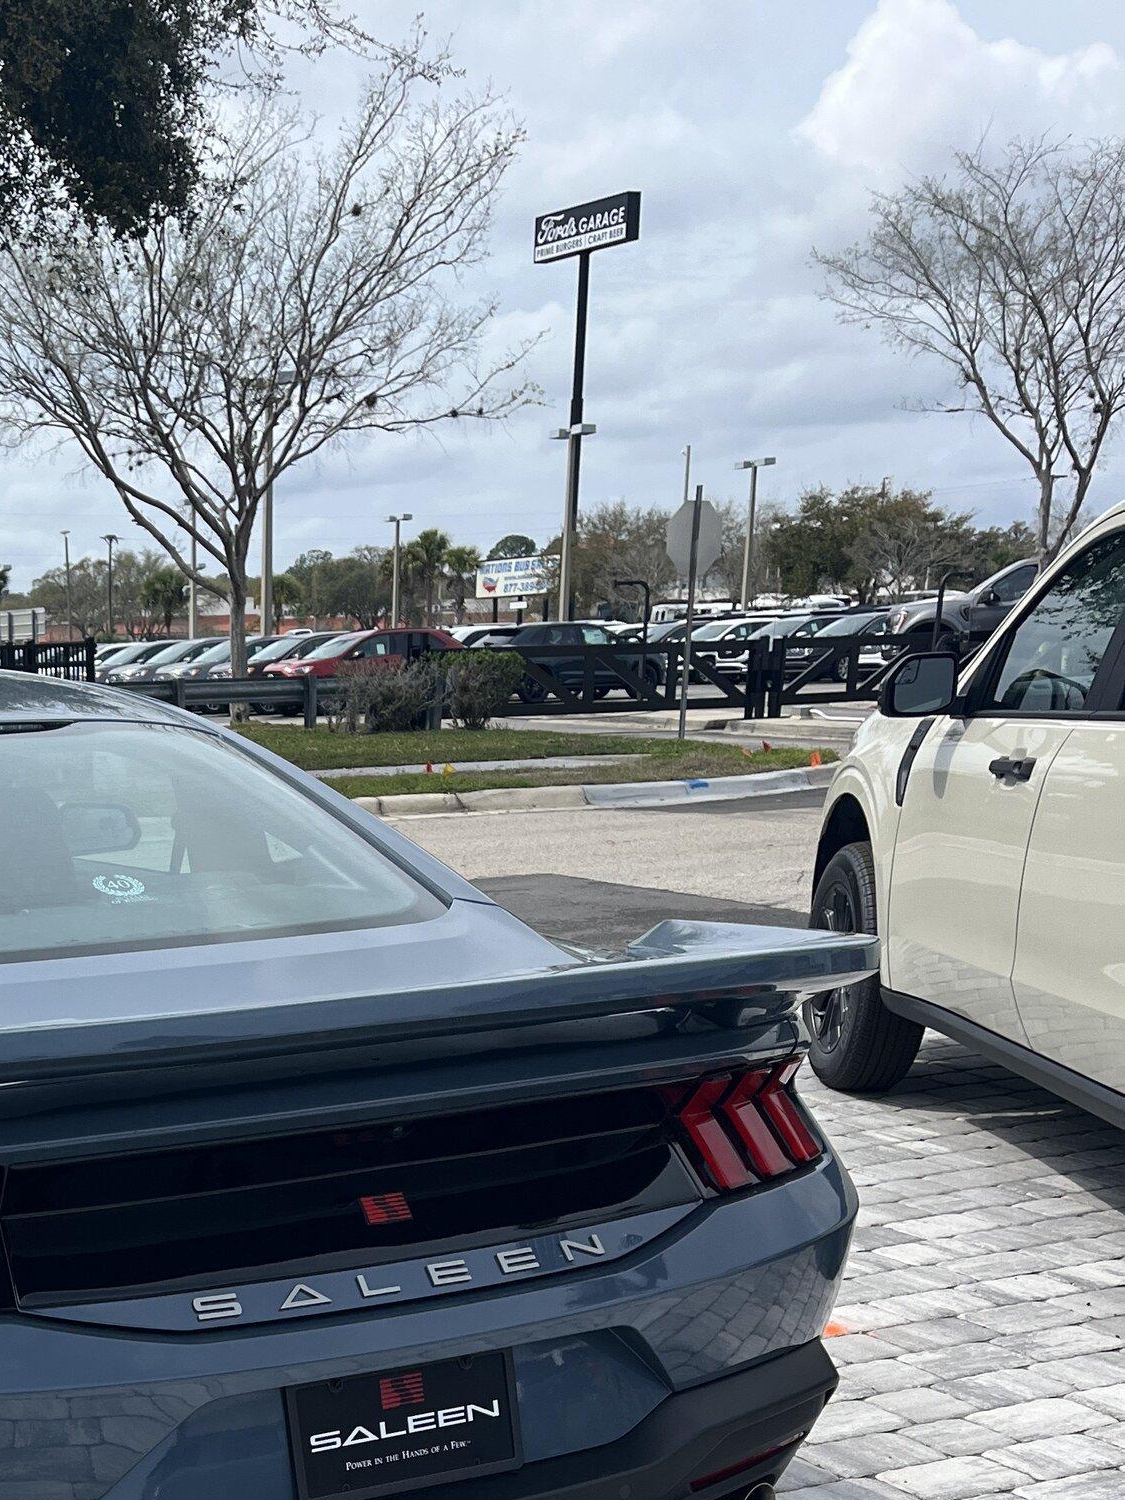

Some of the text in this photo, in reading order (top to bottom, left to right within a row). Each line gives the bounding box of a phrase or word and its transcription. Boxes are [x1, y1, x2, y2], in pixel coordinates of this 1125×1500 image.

[578, 206, 626, 233] GARAGE
[556, 237, 582, 253] BURGERS
[588, 231, 607, 244] CRAFT
[609, 227, 624, 239] BEER
[514, 560, 530, 571] BUS
[107, 879, 131, 889] 40
[193, 1233, 606, 1320] SALEEN
[309, 1399, 500, 1453] SALEEN
